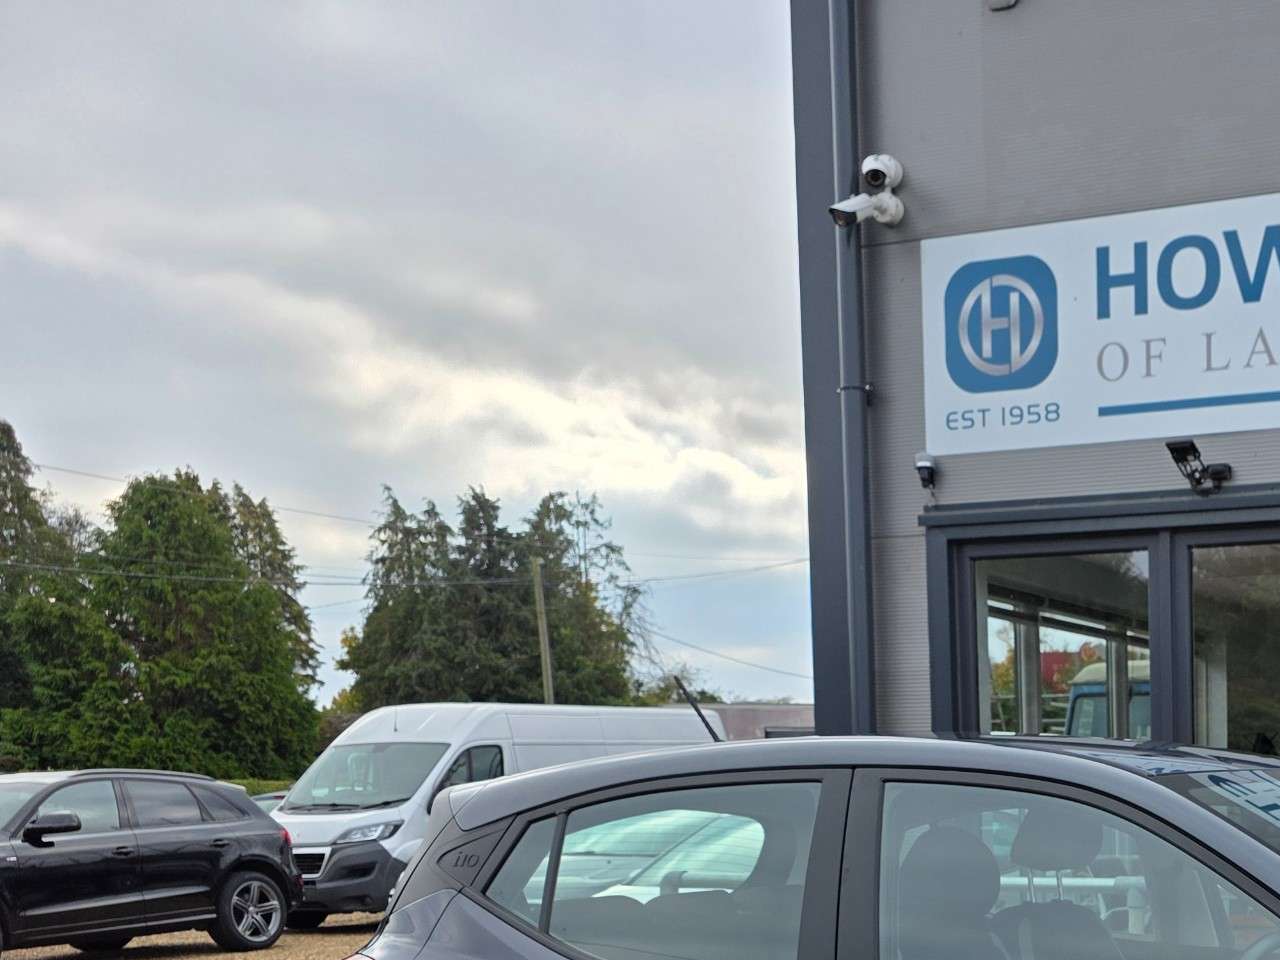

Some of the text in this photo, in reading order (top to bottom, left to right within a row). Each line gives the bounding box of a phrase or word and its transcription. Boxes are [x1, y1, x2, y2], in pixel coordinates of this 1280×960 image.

[1098, 337, 1168, 384] OF
[946, 402, 1061, 431] EST 1958
